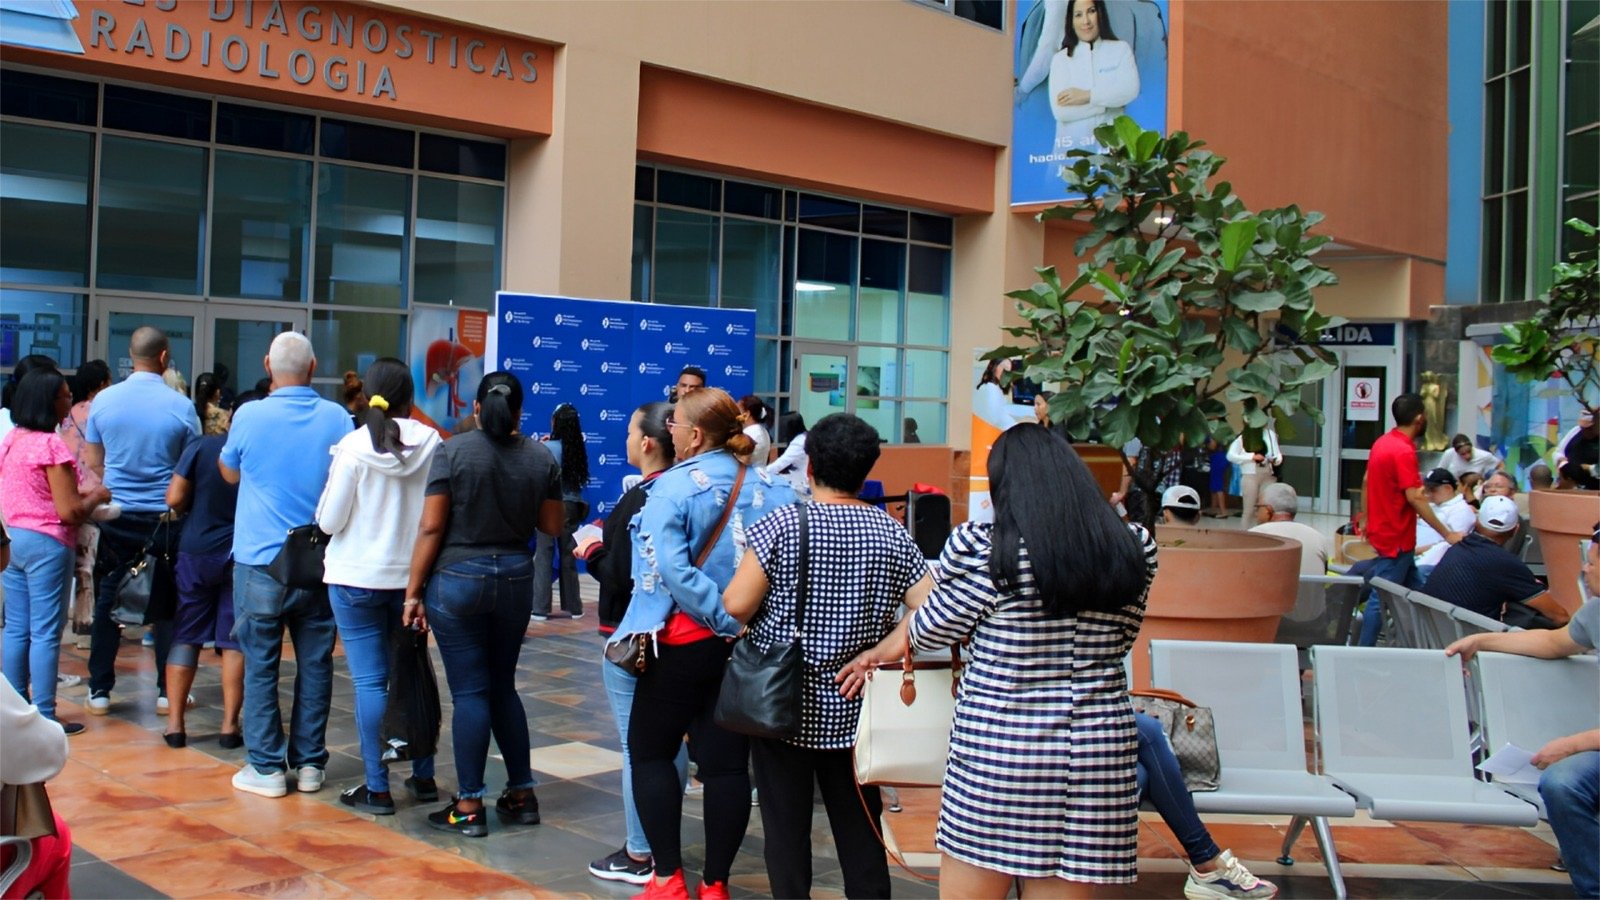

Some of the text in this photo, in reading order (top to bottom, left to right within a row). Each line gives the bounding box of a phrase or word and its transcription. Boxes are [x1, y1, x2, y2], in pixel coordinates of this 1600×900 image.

[90, 8, 398, 101] RADIOLOGIA
[208, 0, 539, 84] DIAGNOSTICAS
[1319, 326, 1374, 343] LIDA
